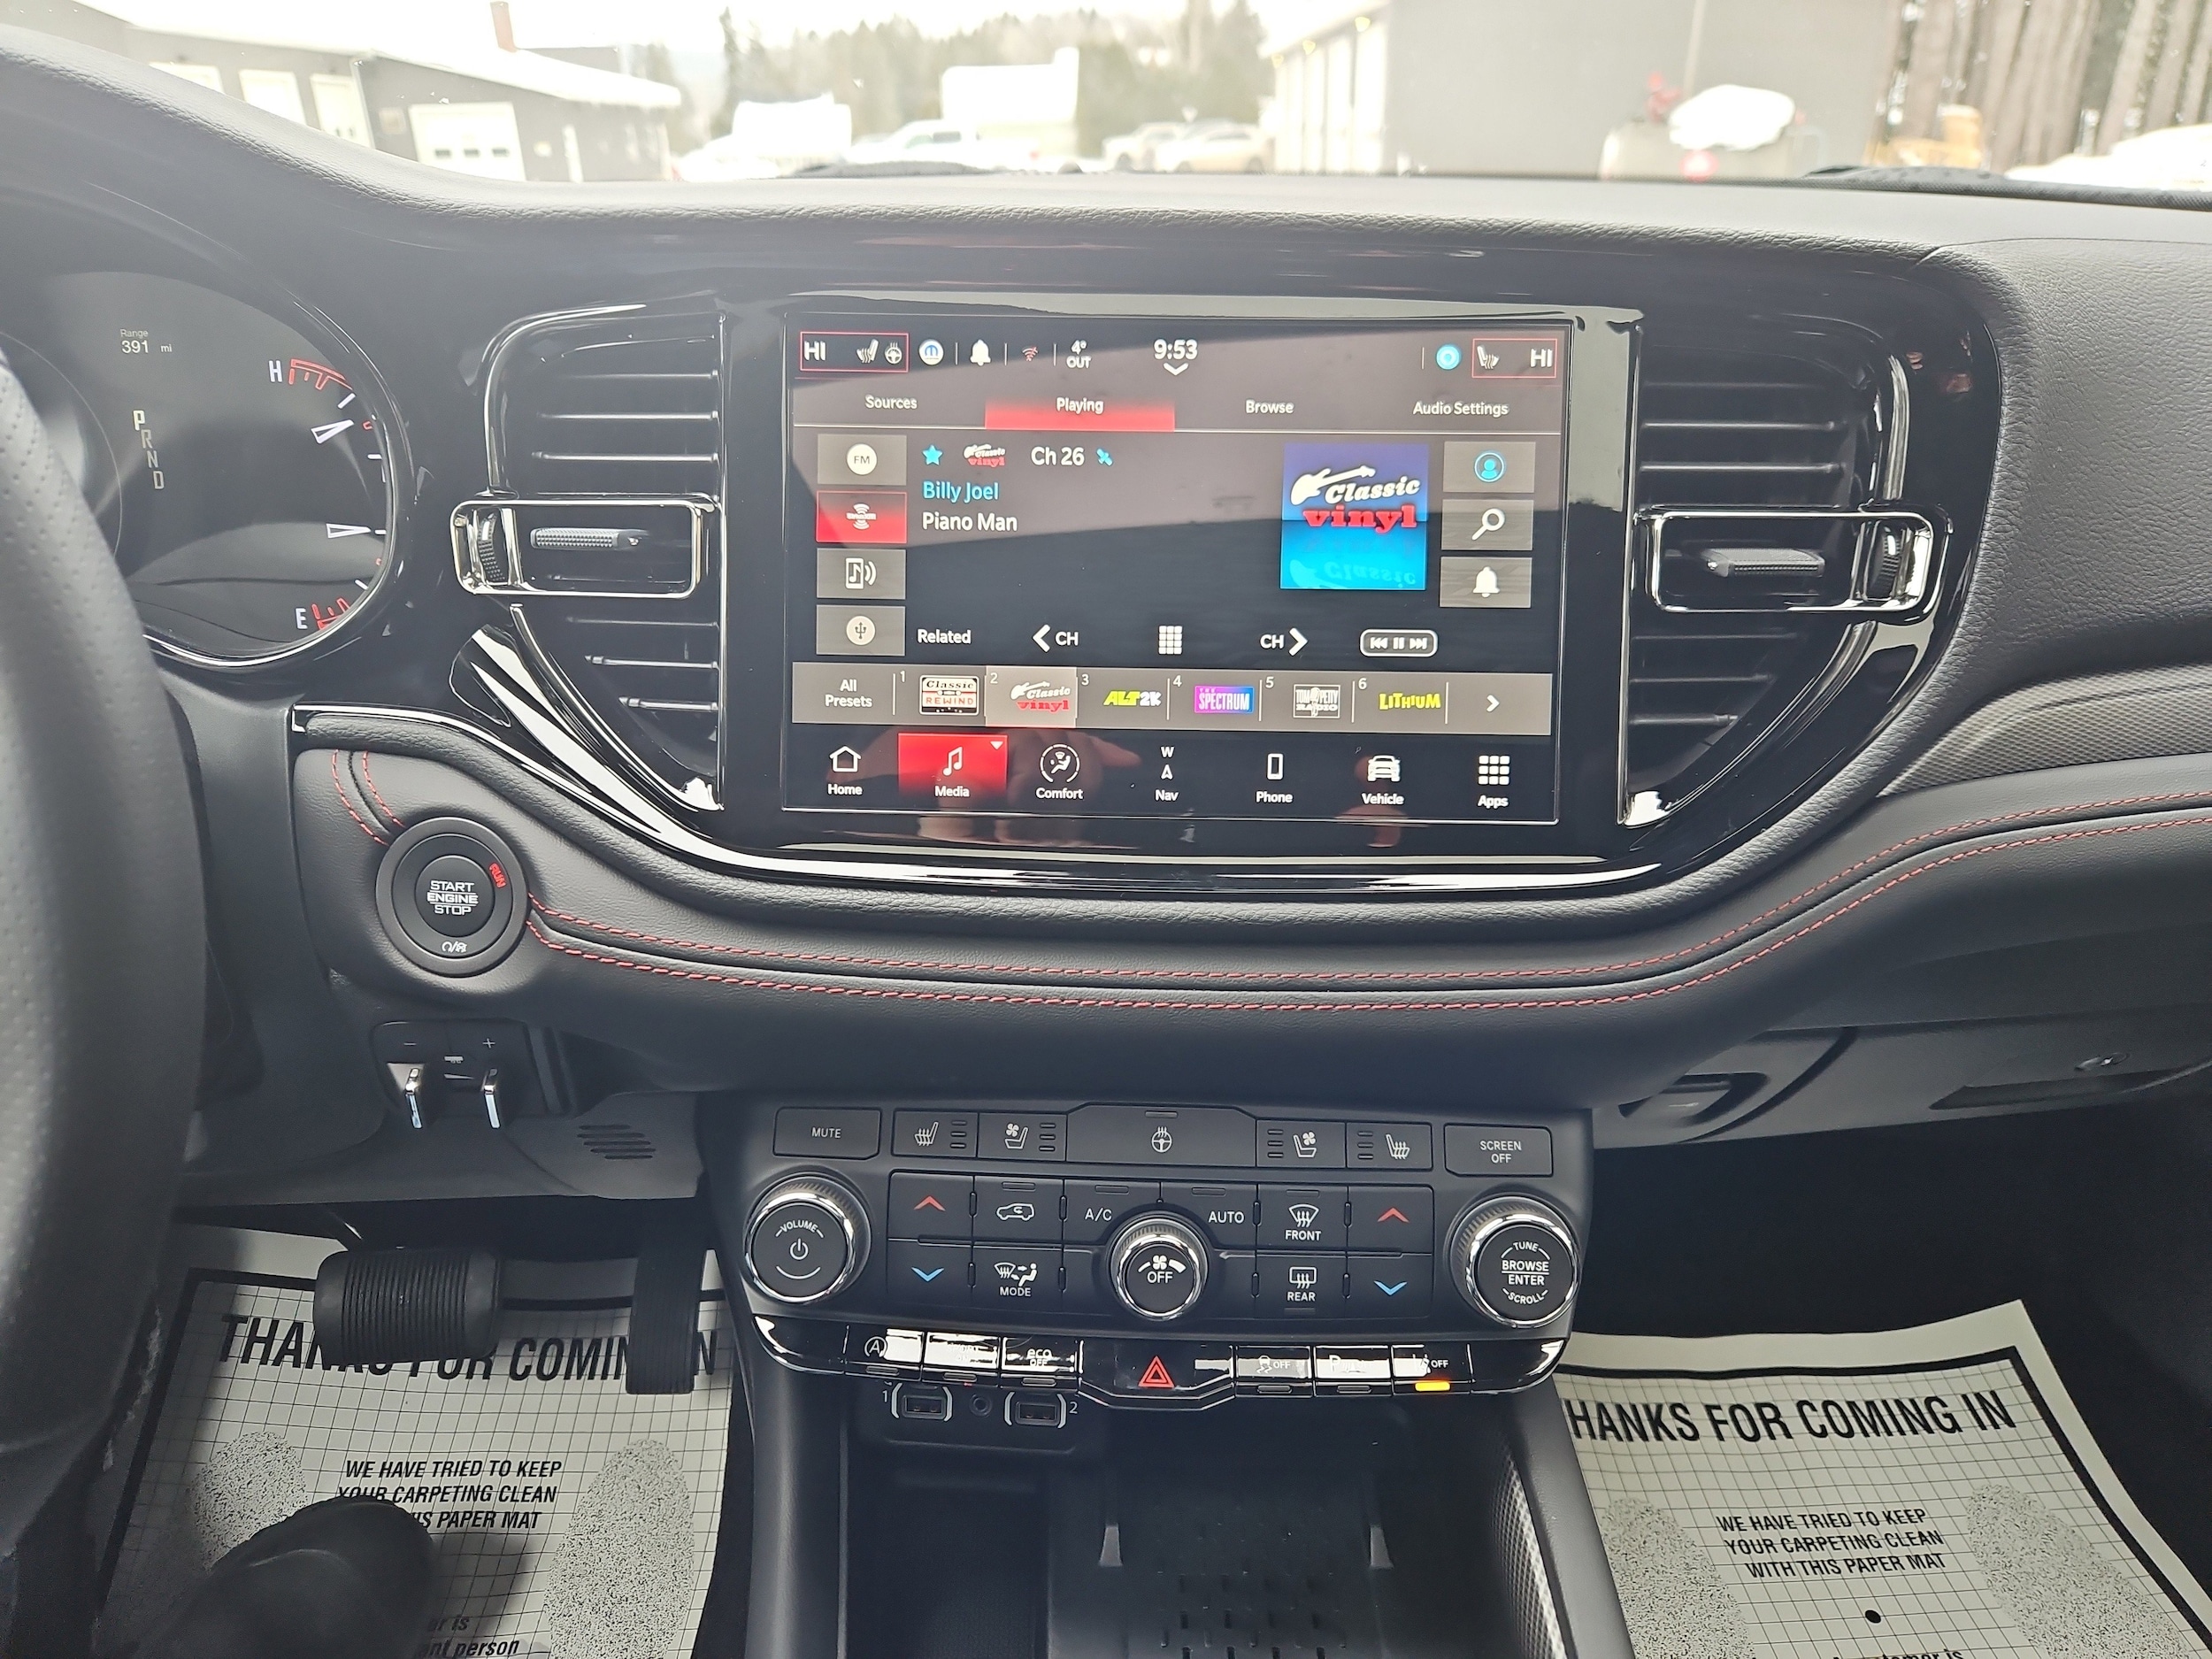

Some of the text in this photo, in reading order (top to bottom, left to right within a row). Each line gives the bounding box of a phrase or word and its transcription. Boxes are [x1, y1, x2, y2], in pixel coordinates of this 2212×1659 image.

[120, 328, 149, 340] Range
[121, 340, 173, 353] 391 mi
[803, 341, 826, 362] HI
[1154, 339, 1198, 360] 9:53
[1067, 356, 1091, 369] OUT
[1530, 348, 1553, 368] HI
[268, 359, 283, 382] H
[865, 395, 918, 410] Sources
[1056, 397, 1104, 413] Playing
[1245, 399, 1294, 415] Browse
[1413, 401, 1509, 419] Audio Settings
[133, 410, 146, 430] P
[141, 428, 152, 448] R
[146, 449, 158, 469] N
[853, 455, 871, 465] FM
[1031, 447, 1085, 466] Ch 26
[153, 471, 165, 489] D
[923, 481, 999, 503] Billy Joel
[1325, 475, 1420, 505] Classic
[923, 512, 1018, 533] Piano Man
[1302, 504, 1417, 534] vinyl
[295, 608, 308, 629] E
[918, 628, 972, 646] Related
[1056, 632, 1079, 646] CH
[1260, 634, 1284, 649] CH
[900, 671, 906, 682] 1
[990, 672, 999, 684] 2
[1081, 674, 1089, 685] 3
[1172, 676, 1182, 687] 4
[1265, 677, 1274, 688] 5
[840, 679, 857, 693] All
[926, 679, 974, 690] Classic
[1358, 679, 1367, 690] 6
[1026, 684, 1071, 700] Classic
[825, 694, 872, 708] Presets
[926, 696, 973, 706] REWIND
[1018, 700, 1070, 713] vinyl
[1199, 693, 1250, 710] SPECTRUM
[1379, 693, 1441, 710] LITHIUM
[1161, 747, 1175, 757] W
[827, 783, 863, 796] Home
[934, 786, 970, 798] Media
[1035, 787, 1084, 800] Comfort
[1155, 789, 1179, 802] Nav
[1256, 791, 1293, 804] Phone
[1362, 793, 1404, 806] Vehicle
[1478, 795, 1509, 809] Apps
[488, 863, 506, 888] RUN
[430, 880, 474, 892] START
[426, 892, 479, 904] ENGINE
[434, 904, 472, 915] STOP
[811, 1126, 841, 1139] MUTE
[1479, 1140, 1522, 1152] SCREEN
[1491, 1152, 1512, 1164] OFF
[1085, 1207, 1112, 1222] A/C
[1208, 1210, 1245, 1224] AUTO
[780, 1220, 819, 1233] VOLUME
[1285, 1230, 1321, 1241] FRONT
[1513, 1241, 1538, 1253] TUNE
[1502, 1260, 1549, 1272] BROWSE
[1147, 1271, 1173, 1284] OFF
[1508, 1274, 1545, 1286] ENTER
[999, 1286, 1032, 1298] MODE
[1286, 1292, 1316, 1302] REAR
[1507, 1291, 1545, 1305] SCROLL
[1026, 1348, 1052, 1360] eco
[1431, 1359, 1449, 1369] OFF
[882, 1391, 889, 1402] 1
[1069, 1402, 1079, 1415] 2
[1563, 1389, 2016, 1442] HANKS FOR COMING IN
[345, 1460, 562, 1478] WE HAVE TRIED TO KEEP
[392, 1486, 493, 1503] CARPETING
[498, 1486, 557, 1503] CLEAN
[437, 1511, 495, 1529] PAPER
[501, 1511, 542, 1529] MAT
[1716, 1508, 1927, 1532] WE HAVE TRIED TO KEEP
[1724, 1530, 1945, 1556] YOUR CARPETING CLEAN
[1745, 1553, 1947, 1578] WITH THIS PAPER MAT
[454, 1640, 519, 1659] person
